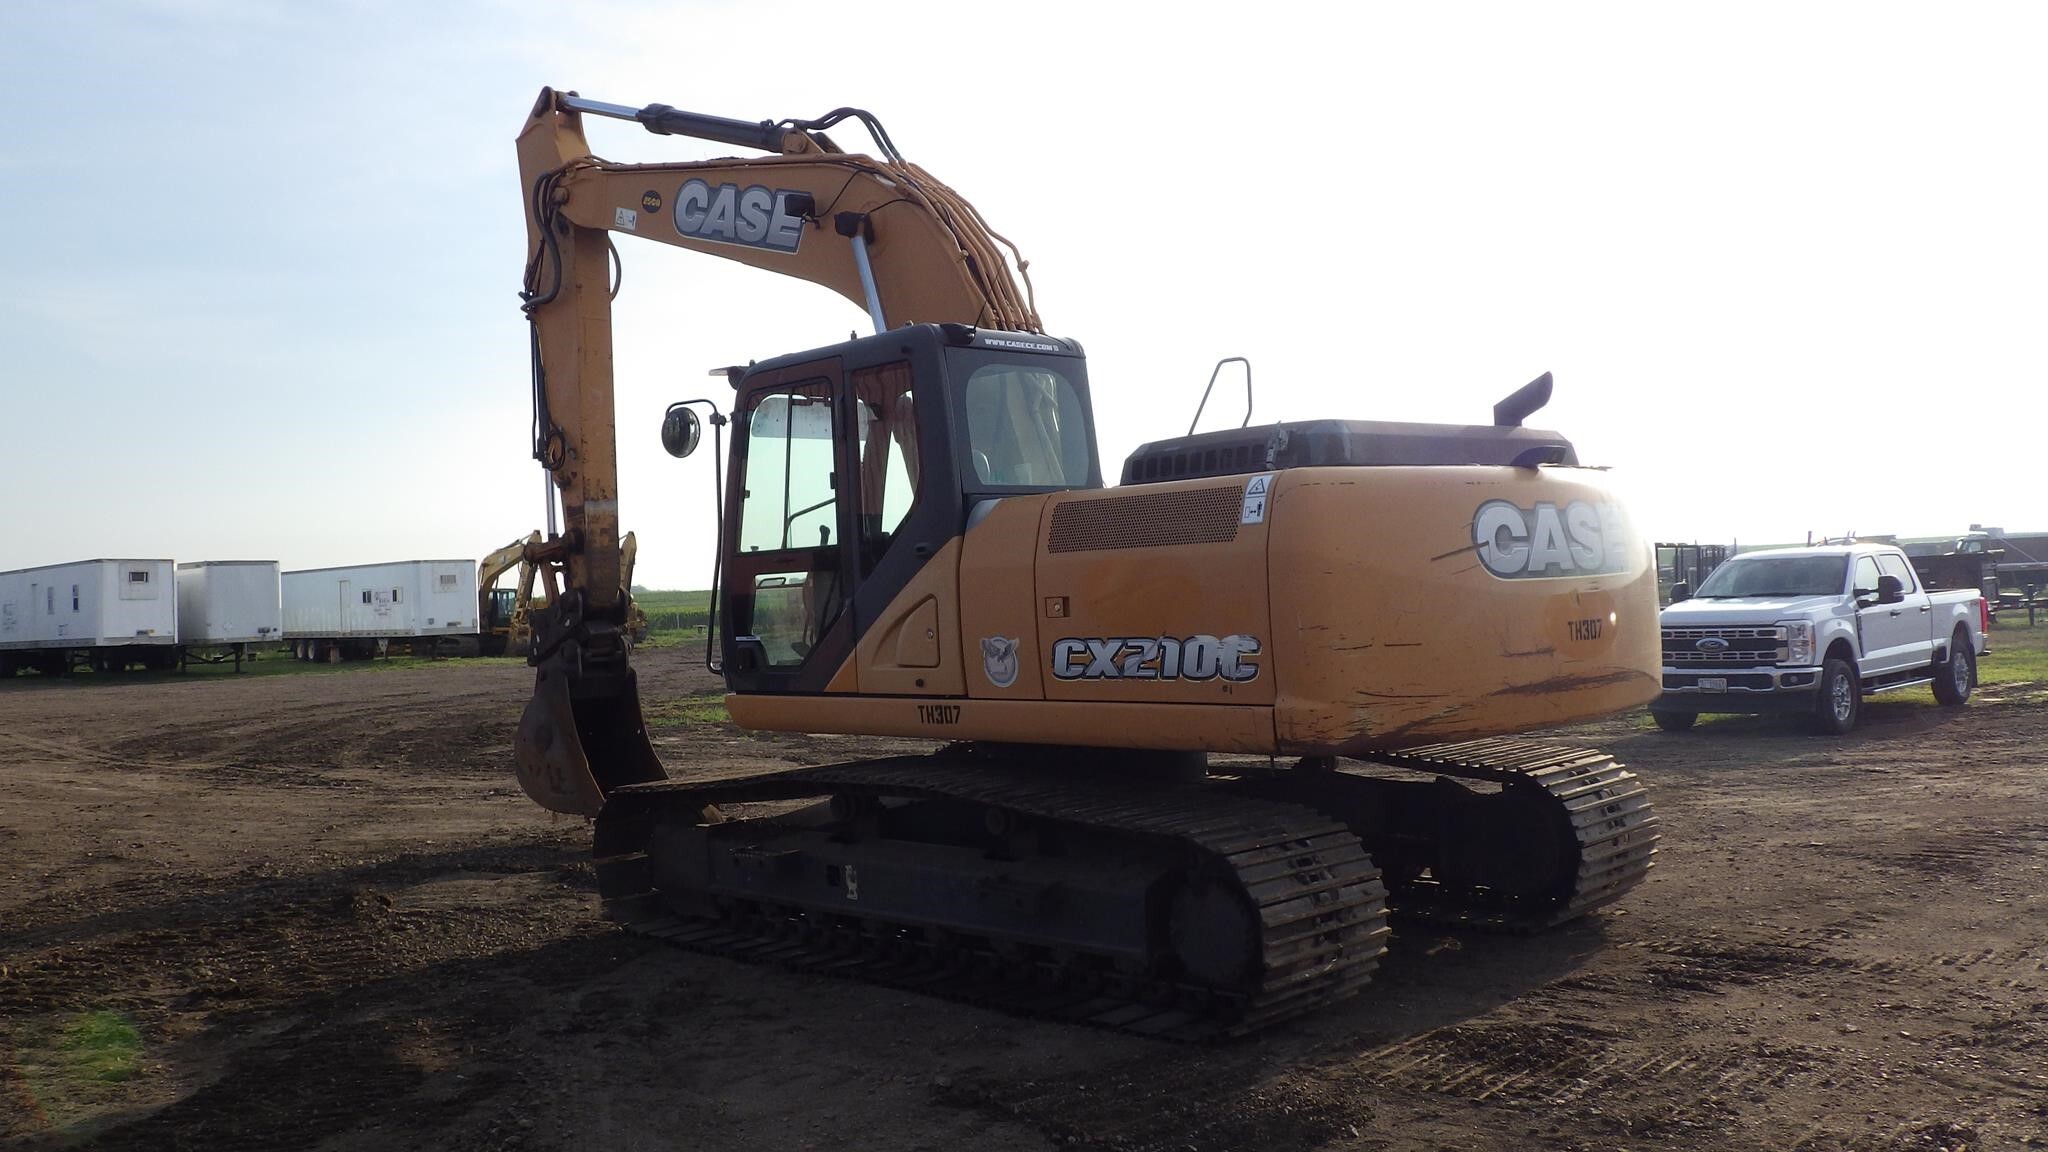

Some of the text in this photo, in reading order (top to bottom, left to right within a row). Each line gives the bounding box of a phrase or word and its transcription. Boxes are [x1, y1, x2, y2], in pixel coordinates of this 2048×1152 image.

[675, 182, 802, 247] CASE
[1477, 503, 1630, 574] CASE
[1568, 618, 1602, 641] TH307
[1053, 637, 1260, 681] CX210C
[917, 704, 960, 724] TH307
